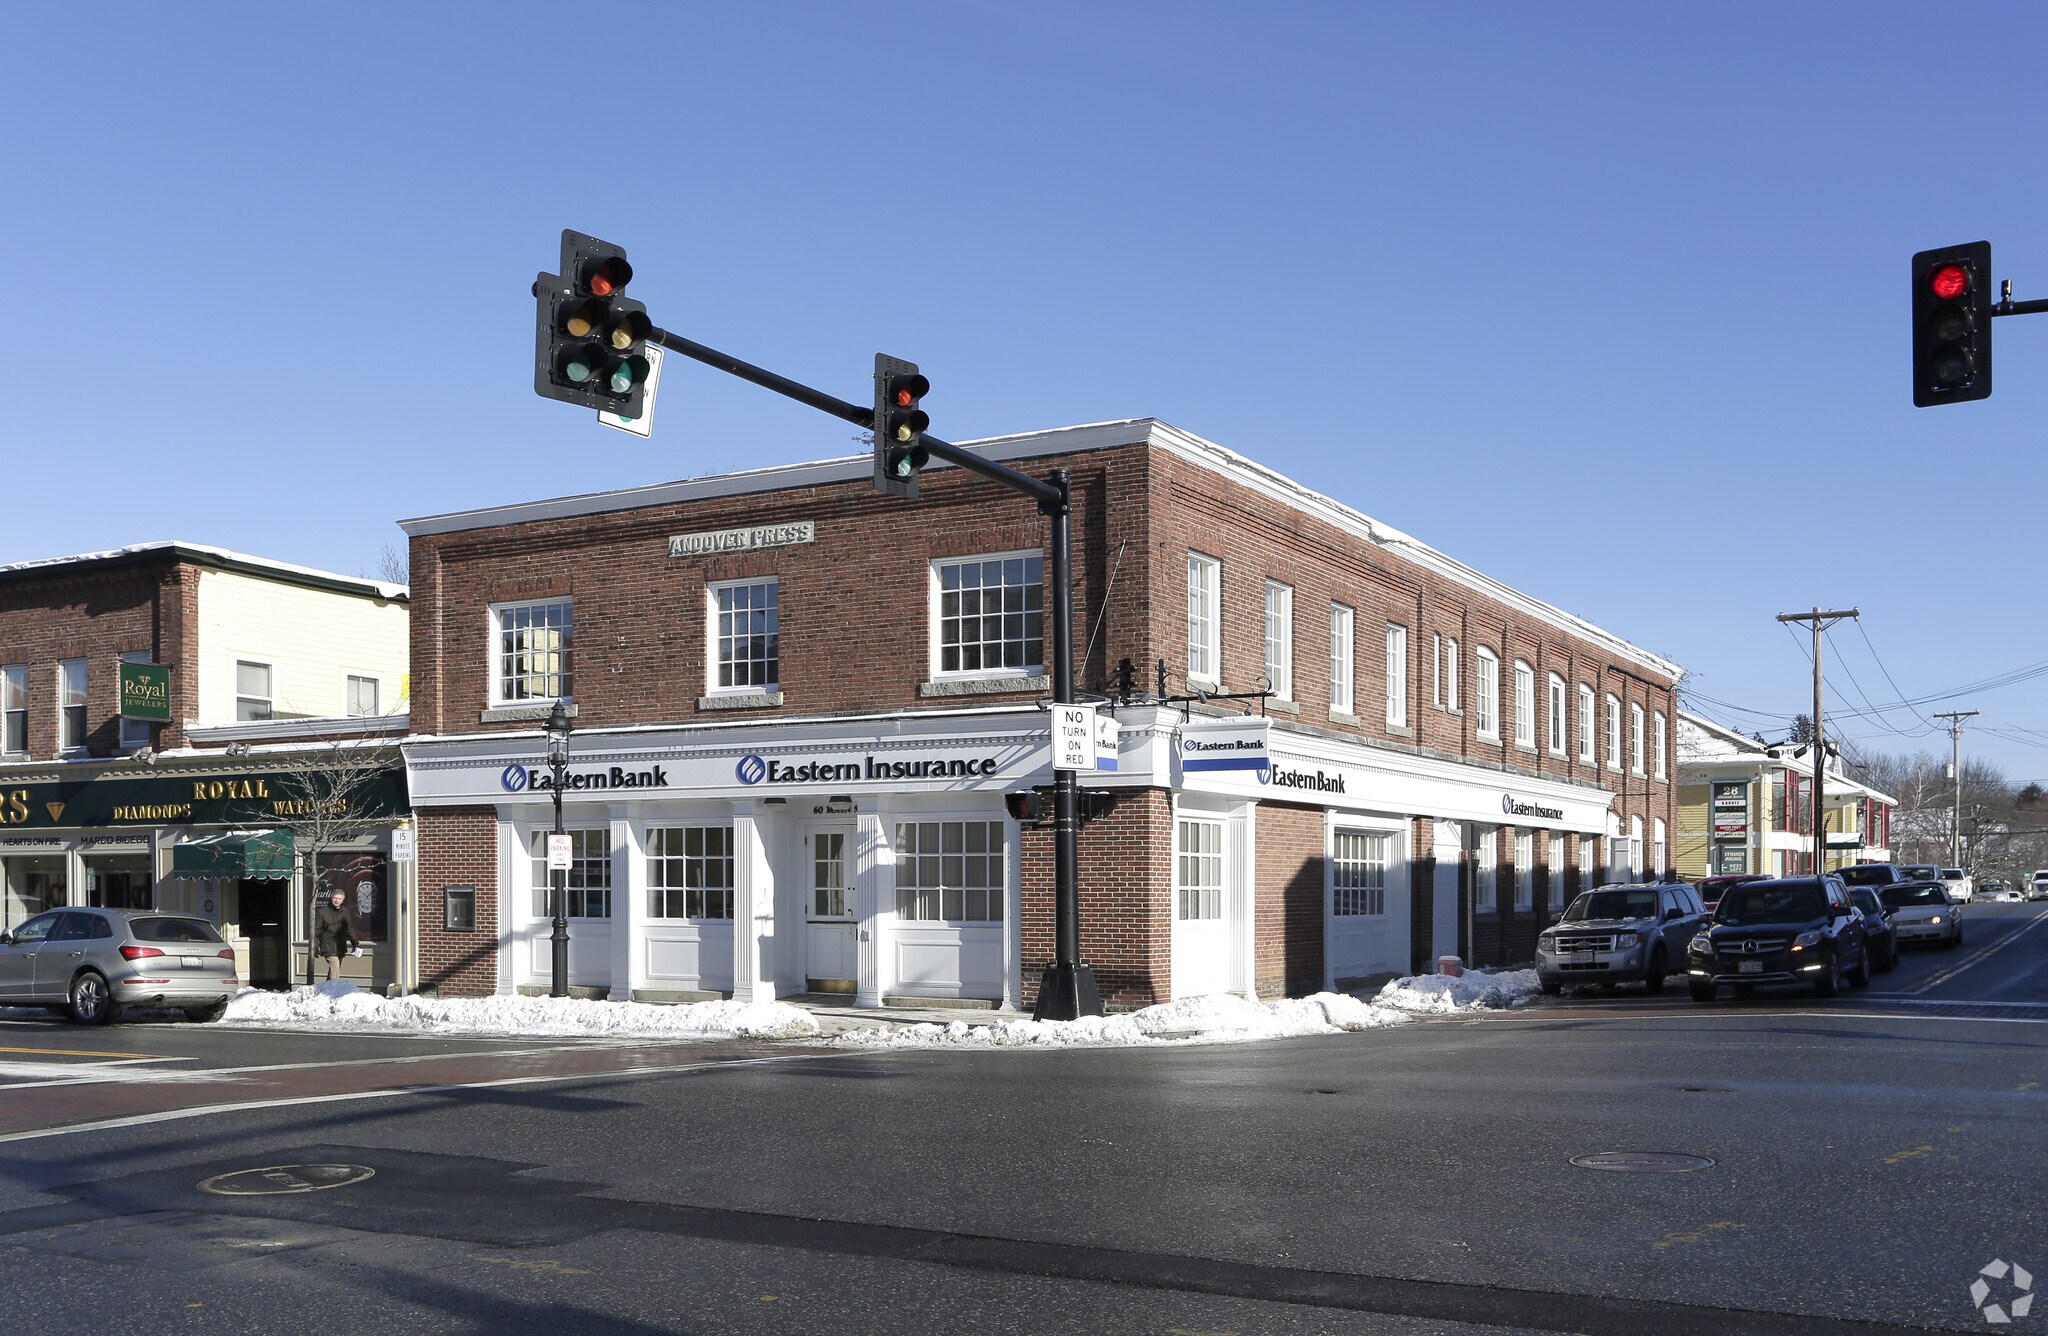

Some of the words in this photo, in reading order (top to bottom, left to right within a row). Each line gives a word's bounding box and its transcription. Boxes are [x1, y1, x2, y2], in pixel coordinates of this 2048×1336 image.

[670, 531, 748, 555] ANDOVER
[751, 524, 811, 547] PRESS
[125, 680, 166, 700] Royal
[125, 699, 167, 709] JEWELERS
[1065, 711, 1083, 723] NO
[1062, 727, 1086, 737] TURN
[1068, 741, 1081, 750] ON
[1197, 741, 1235, 751] Eastern
[1236, 740, 1264, 750] Bank
[1066, 755, 1084, 764] RED
[766, 759, 861, 784] Eastern
[864, 756, 997, 781] Insurance
[193, 779, 269, 800] ROYAL
[1723, 786, 1739, 796] 28
[113, 803, 191, 820] DIAMONDS
[813, 806, 824, 814] 60
[1510, 799, 1534, 816] Eastern
[1535, 802, 1563, 820] Insurance
[3, 838, 33, 846] HEARTS
[33, 837, 43, 845] ON
[44, 837, 61, 845] FIRE
[80, 836, 114, 845] MARCO
[115, 835, 150, 844] BICEGO
[399, 832, 407, 841] 15
